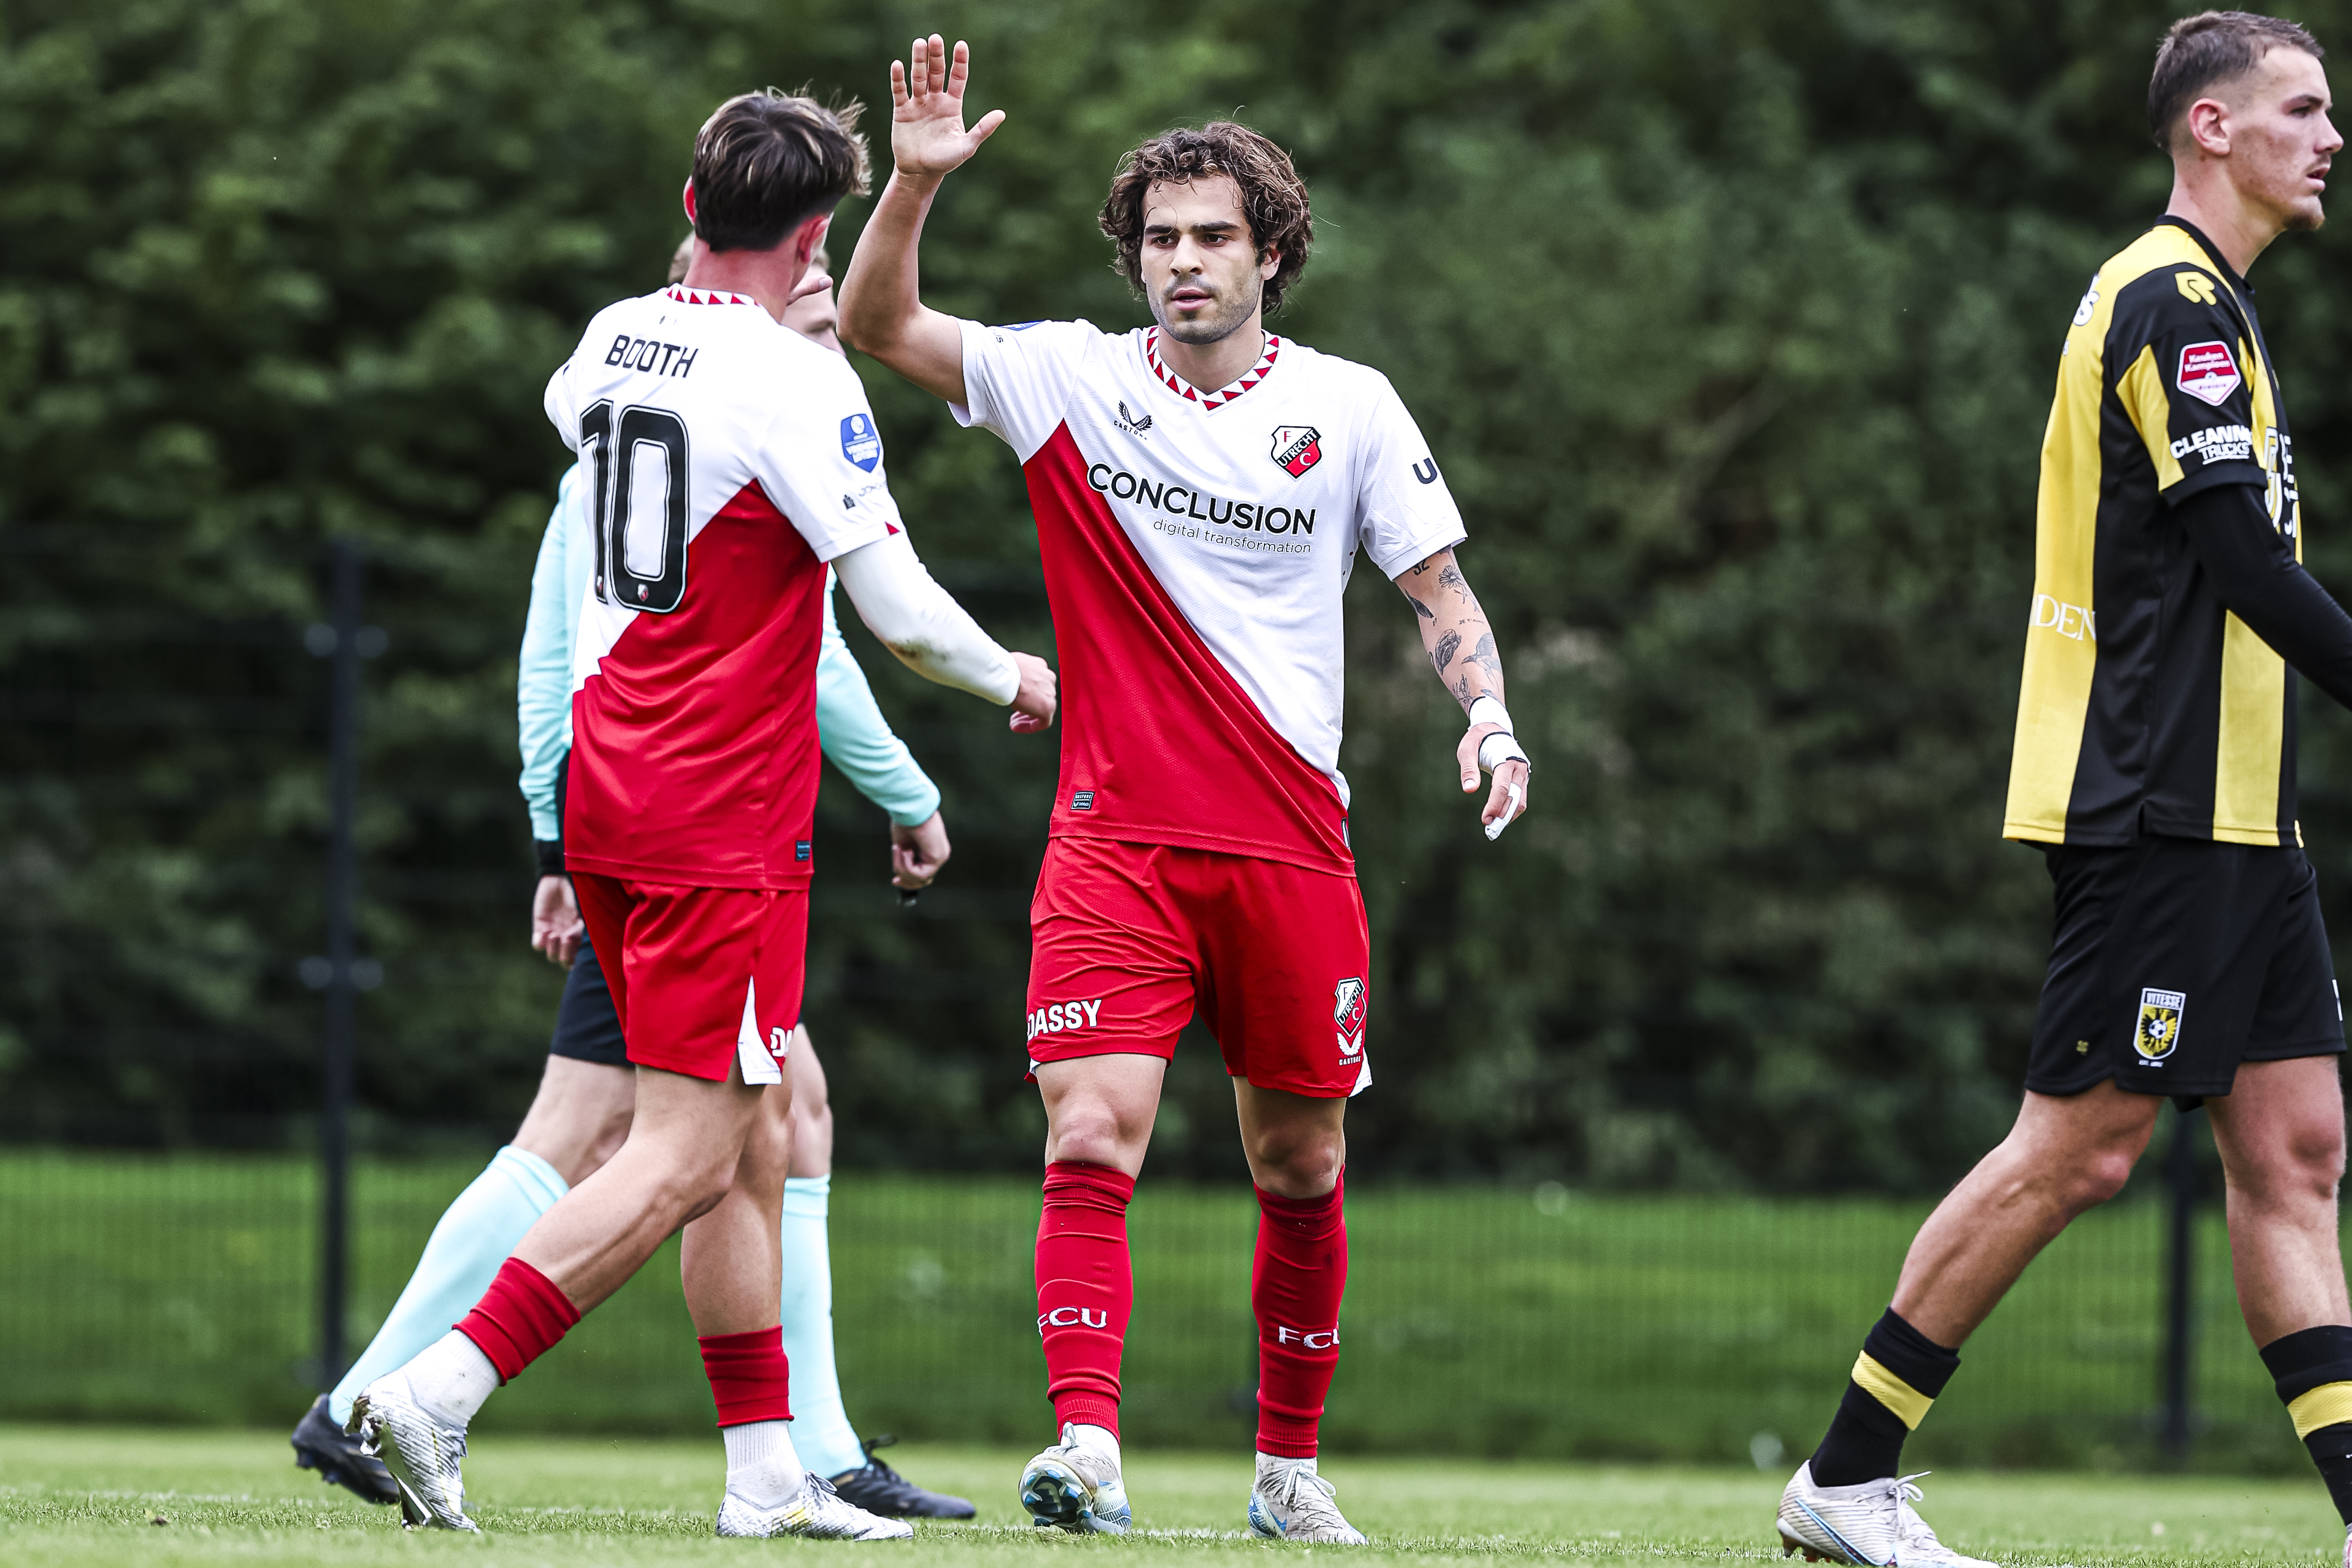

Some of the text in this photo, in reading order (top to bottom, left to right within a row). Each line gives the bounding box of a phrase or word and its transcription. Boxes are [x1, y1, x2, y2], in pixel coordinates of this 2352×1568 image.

[605, 334, 699, 378] BOOTH
[1114, 420, 1147, 441] CASTO
[1277, 429, 1317, 466] UTRECHT
[1284, 430, 1291, 442] F
[1299, 452, 1311, 466] C
[2198, 442, 2249, 460] TRUCKS
[580, 399, 689, 613] 10
[1088, 463, 1316, 535] CONCLUSION
[1154, 519, 1312, 554] digital transformation
[2029, 593, 2096, 641] DEN
[1338, 983, 1362, 1024] UTRECHT
[1344, 987, 1348, 1000] F
[1027, 999, 1102, 1041] DASSY
[1352, 1008, 1359, 1021] C
[1037, 1306, 1107, 1338] FCU
